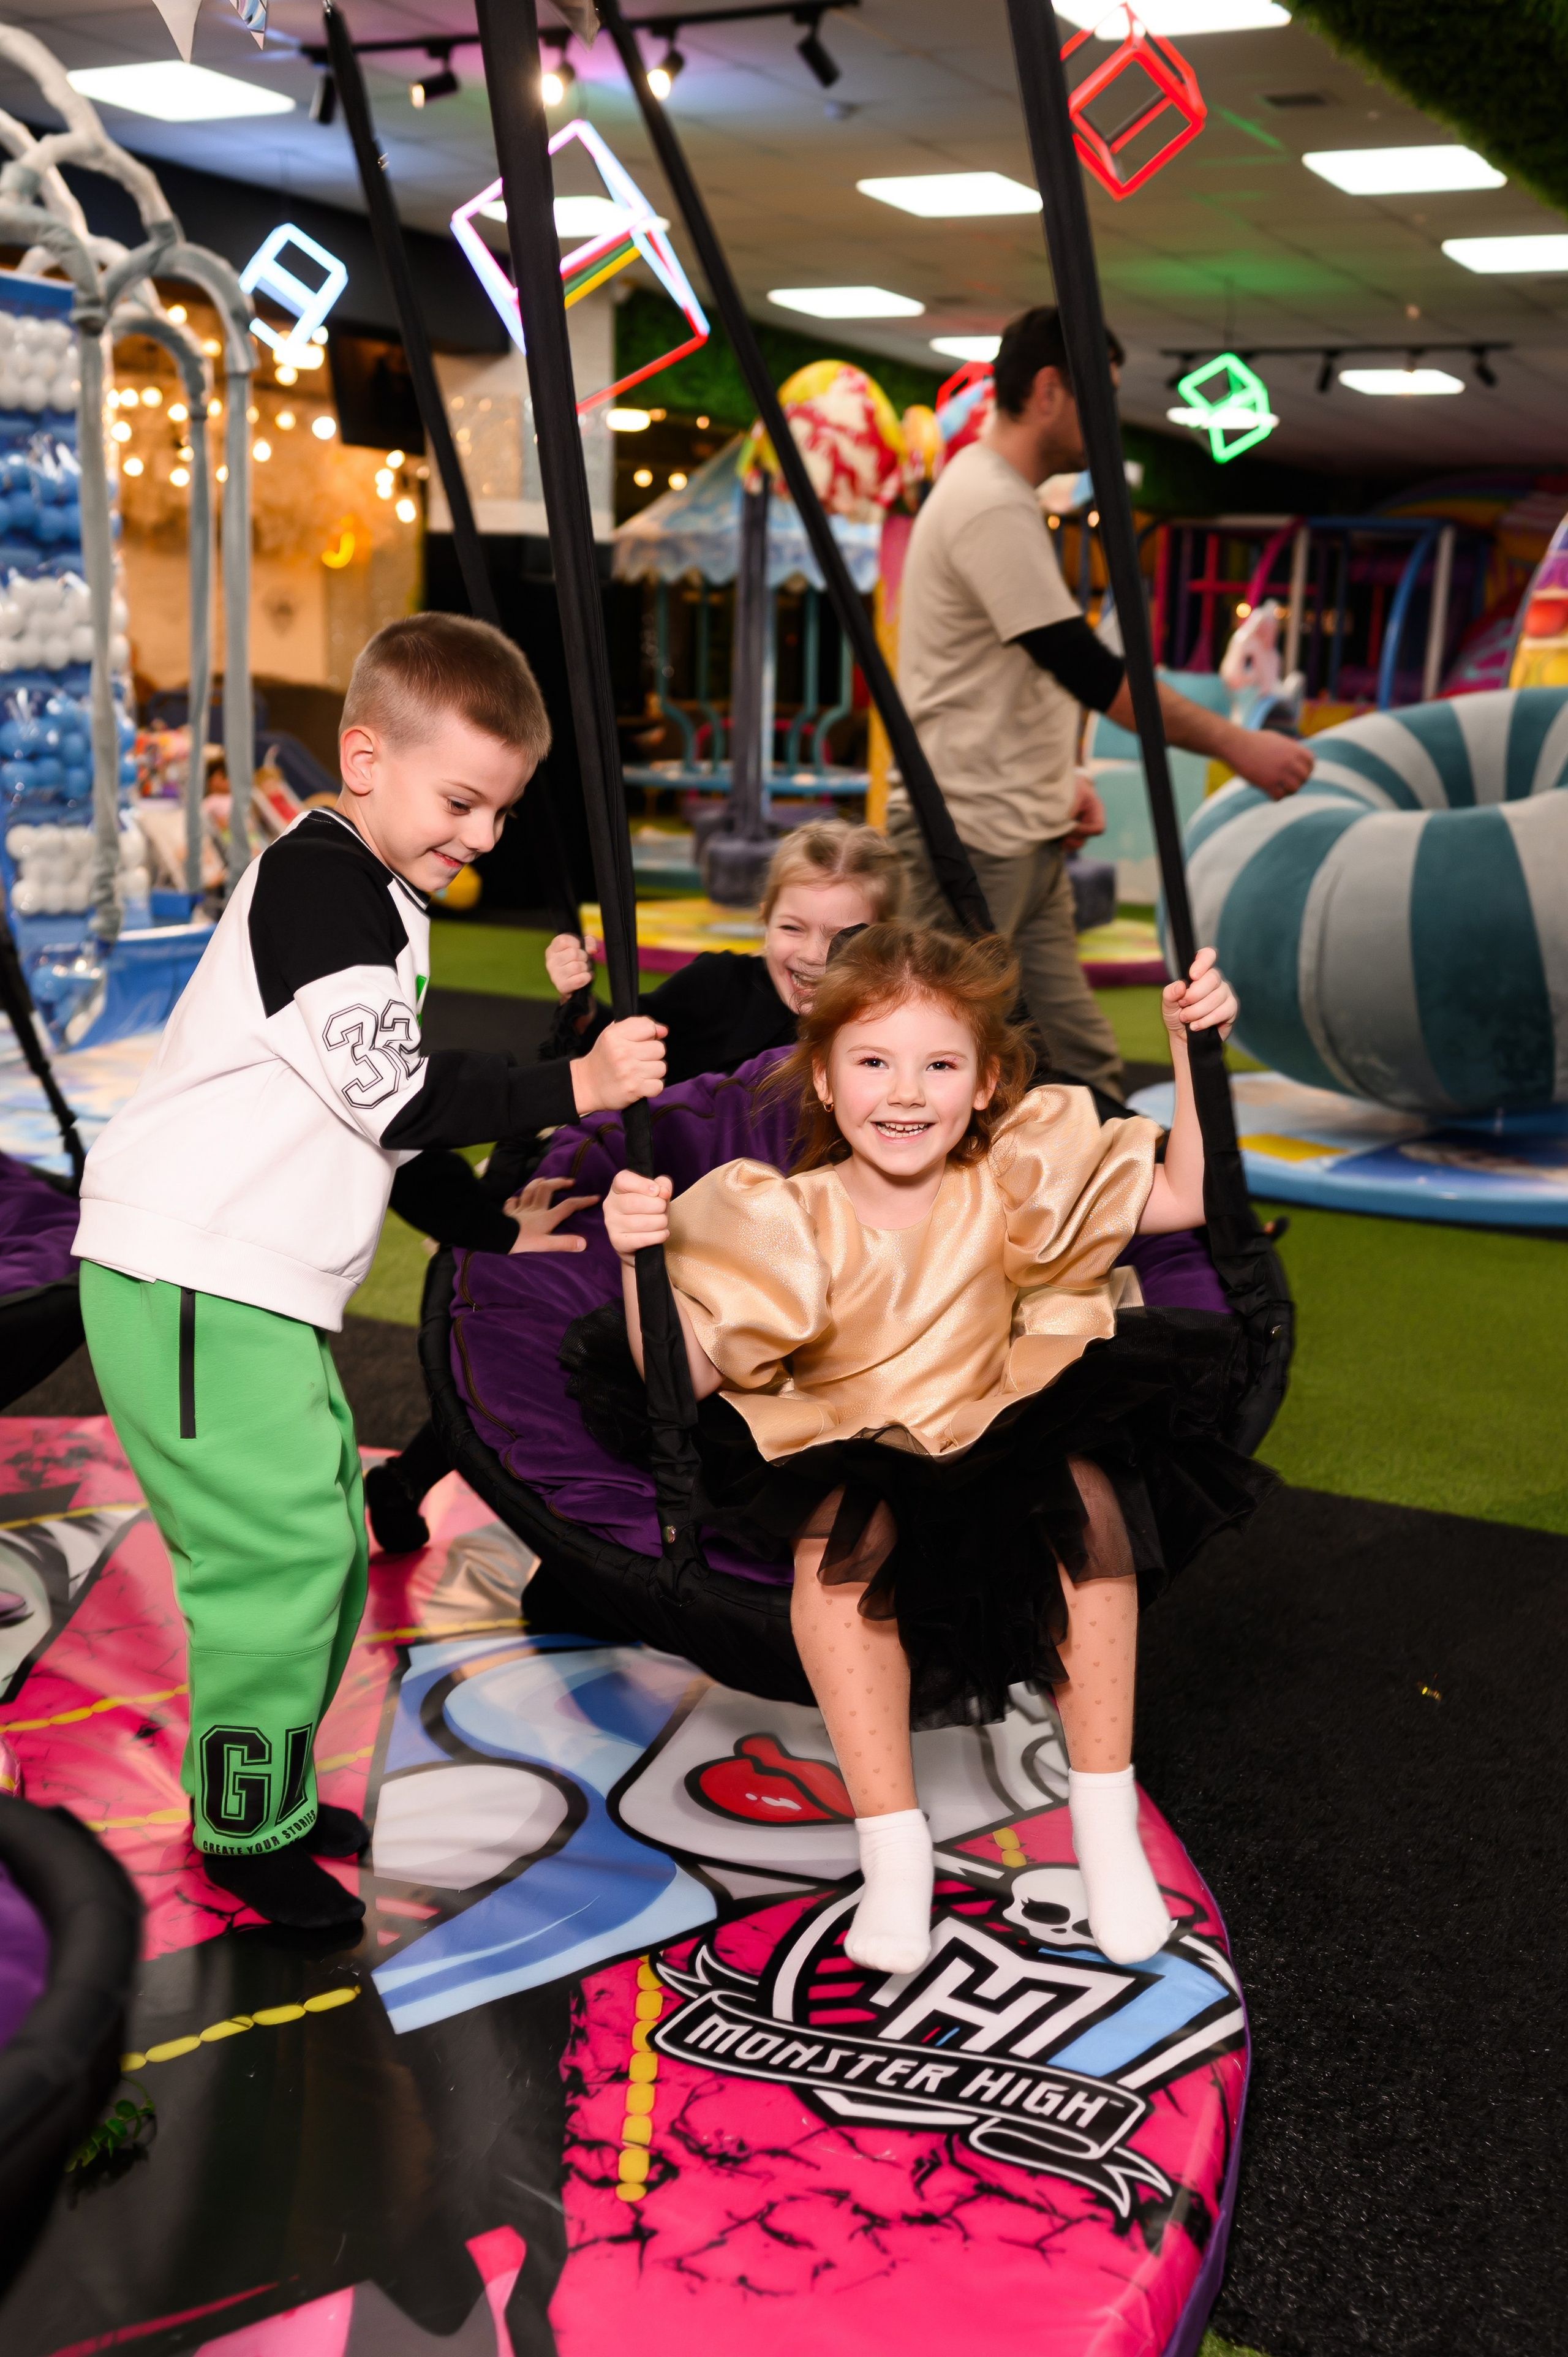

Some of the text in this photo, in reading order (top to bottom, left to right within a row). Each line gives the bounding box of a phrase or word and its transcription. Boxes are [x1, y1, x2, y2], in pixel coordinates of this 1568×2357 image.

[203, 1840, 243, 1855] CREATE
[246, 1835, 281, 1855] YOUR
[281, 1809, 317, 1840] STORIES
[684, 2012, 1109, 2129] MONSTER HIGH
